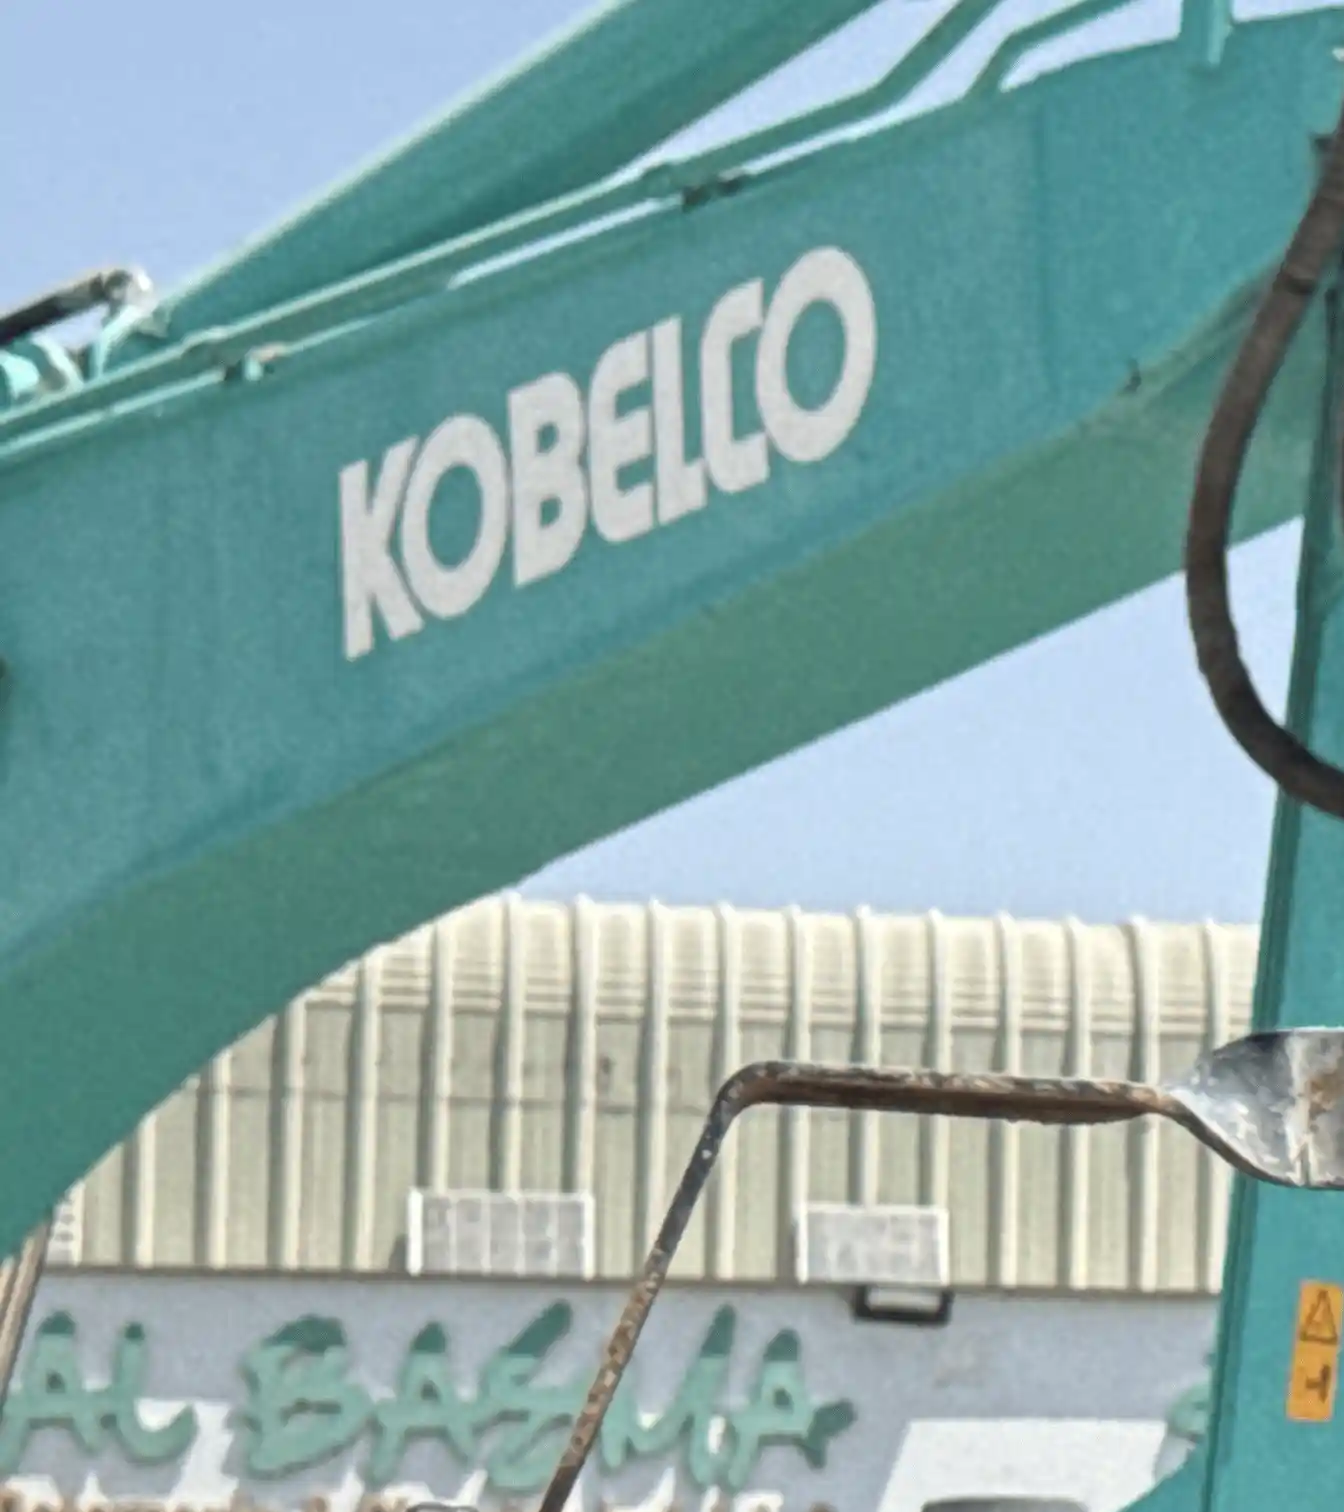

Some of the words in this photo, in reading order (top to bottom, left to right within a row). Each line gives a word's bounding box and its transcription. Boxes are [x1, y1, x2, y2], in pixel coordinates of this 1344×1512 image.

[339, 246, 876, 662] KOBELCO
[0, 1310, 196, 1474] AL
[242, 1299, 857, 1487] BASMA
